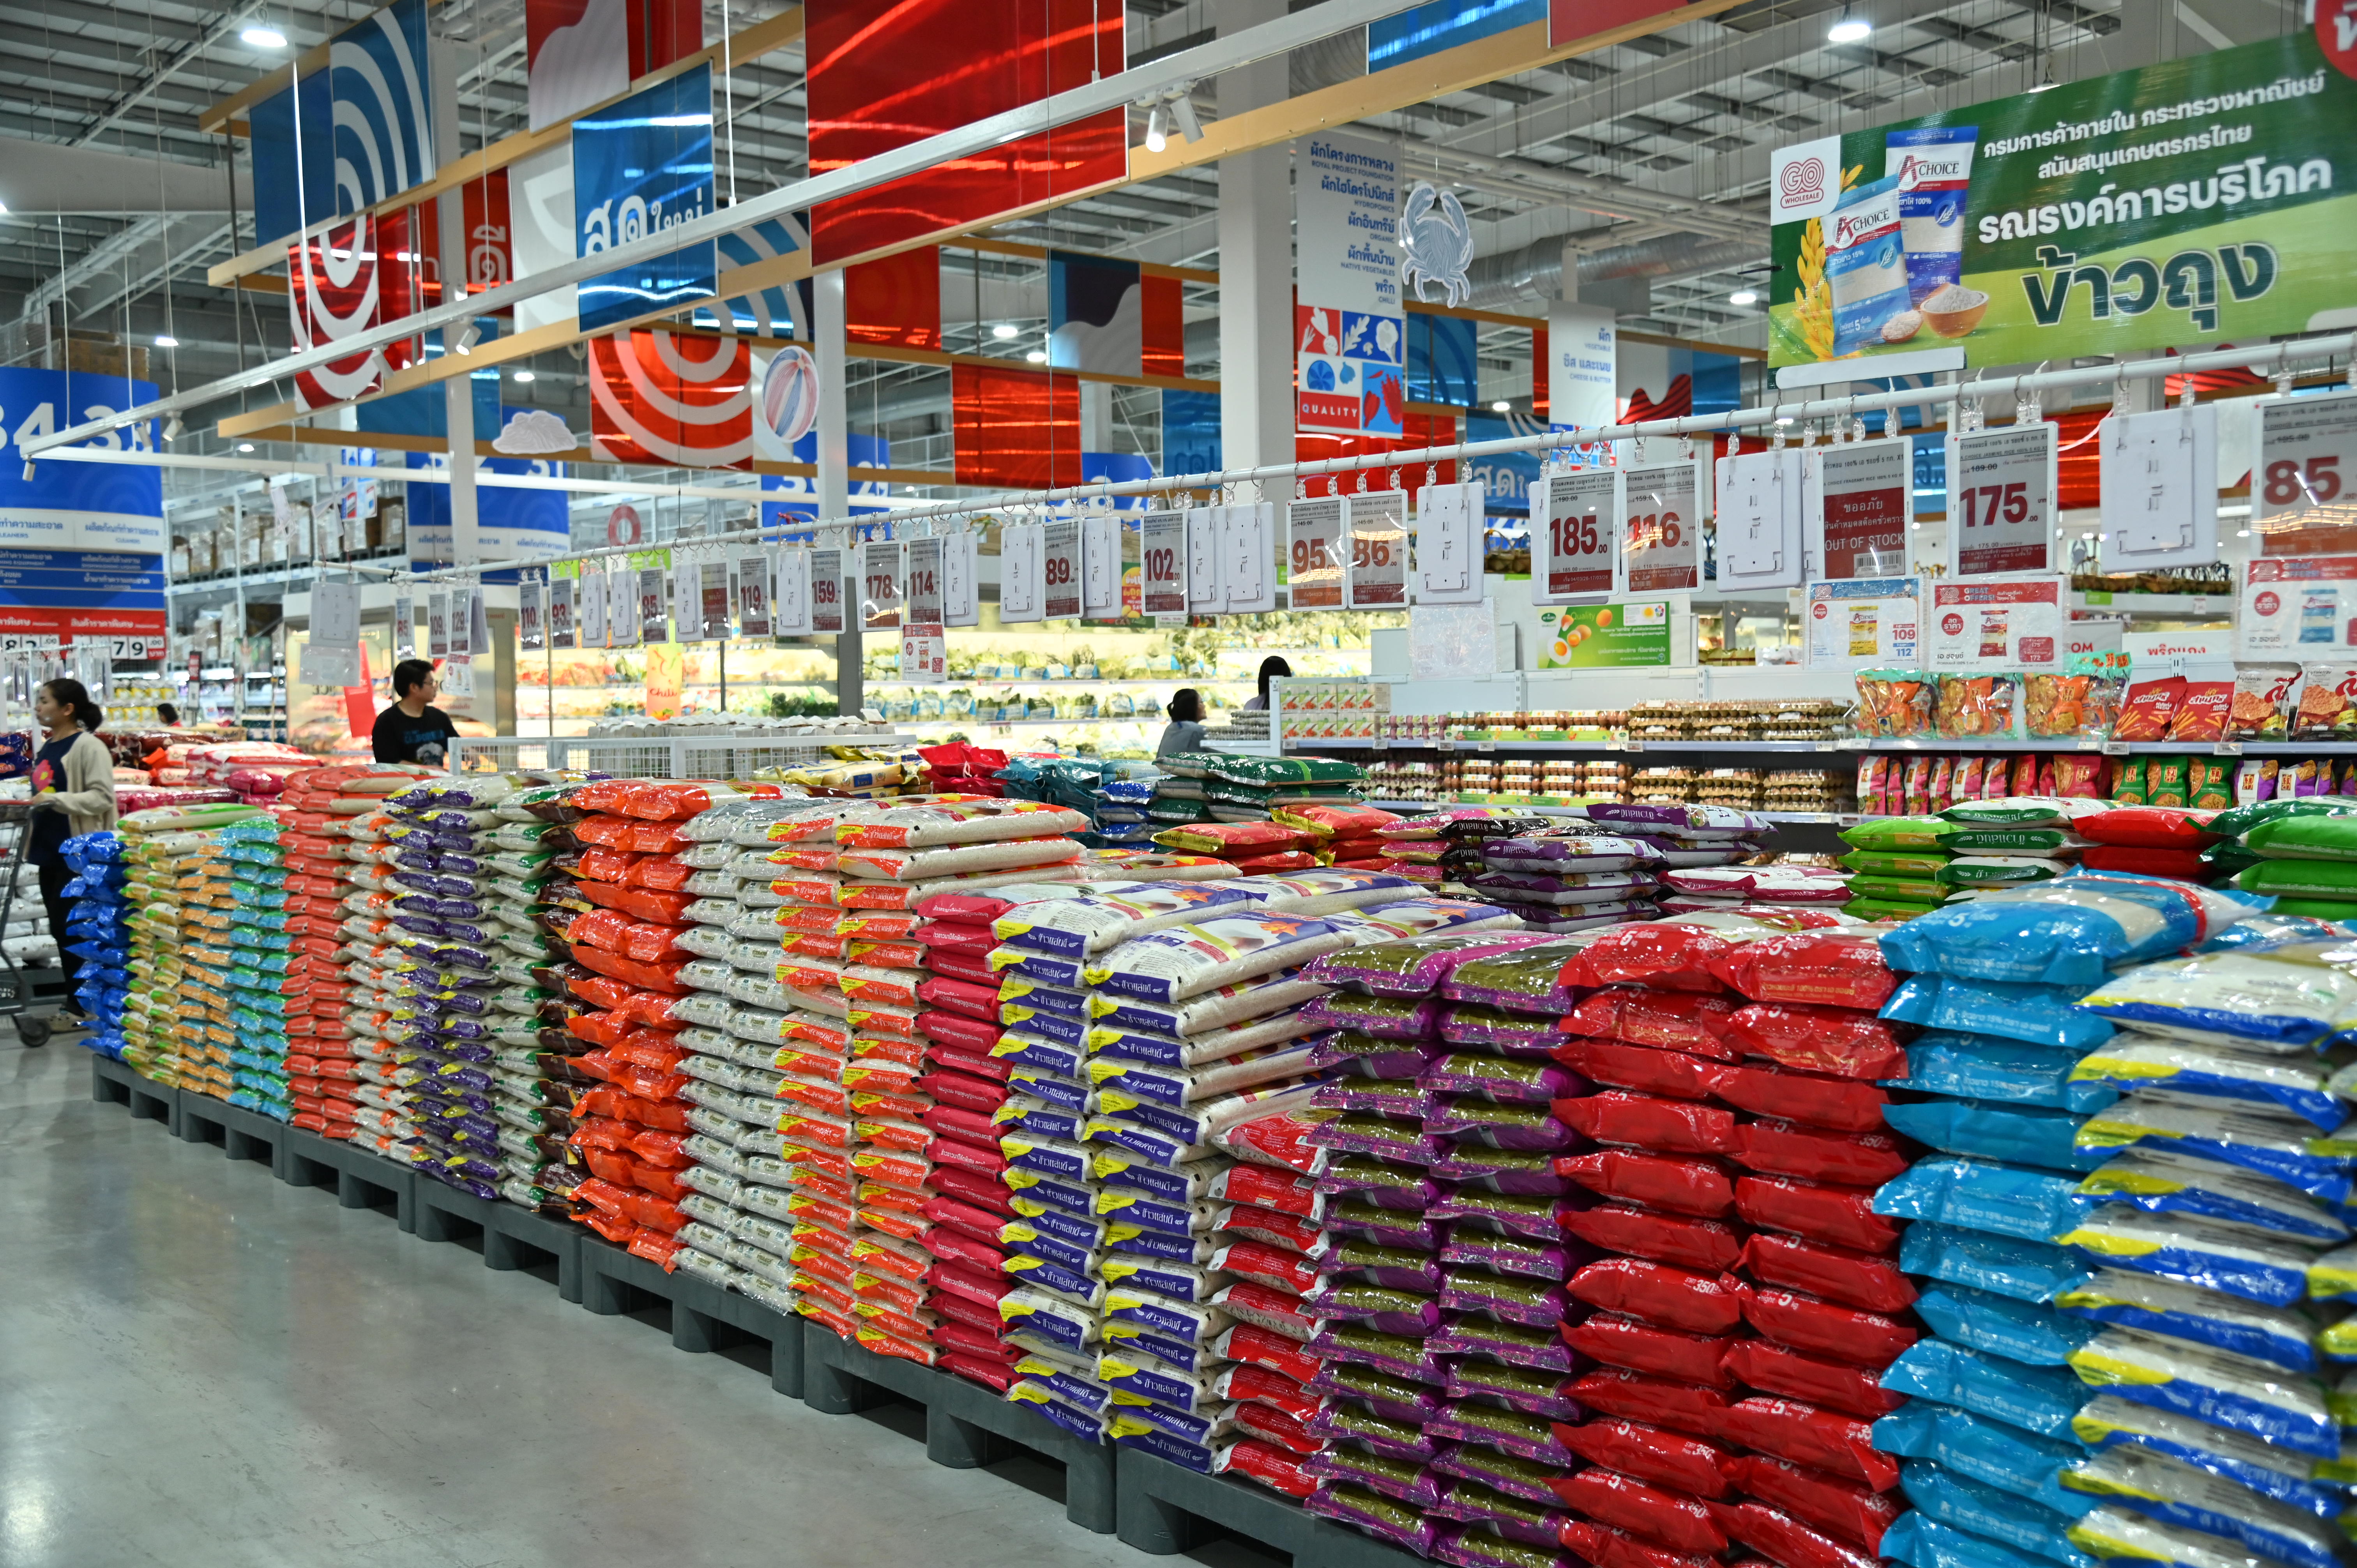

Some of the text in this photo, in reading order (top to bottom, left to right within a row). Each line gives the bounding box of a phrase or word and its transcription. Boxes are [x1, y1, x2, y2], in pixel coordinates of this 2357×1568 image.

[1984, 69, 2326, 157] กรมการค้าภายใน กระทรวงพาณิชย์
[1311, 141, 1394, 172] ผักโครงการหลวง
[2039, 124, 2252, 178] สนับสนุนเกษตรกรไทย
[1312, 161, 1394, 182] ROYAL PROJECT FOUNDATION
[1781, 157, 1824, 195] GO
[1919, 162, 1959, 176] CHOICE
[1322, 175, 1394, 203] ผักไฮโดรโปนิกส์
[1355, 200, 1394, 212] HYDROPONICS
[1785, 192, 1820, 204] WHOLESALE
[1979, 157, 2332, 244] รณรงค์การบริโภค
[1348, 211, 1394, 233] ผักอินทรีย์
[1853, 209, 1890, 231] CHOICE
[1370, 234, 1394, 243] ORGANIC
[1348, 243, 1395, 266] ผักพื้นบ้าน
[1341, 262, 1395, 276] NATIVE VEGETABLES
[1375, 279, 1395, 294] พริก
[2021, 242, 2277, 331] ข้าวถุง
[1599, 328, 1610, 342] ผัก
[1585, 343, 1611, 351] VEGETABLE
[1570, 373, 1588, 381] CHEESE
[1303, 404, 1357, 418] QUALITY
[1960, 440, 1988, 450] ข้าวหอมมะลิ
[1866, 455, 1880, 464] ชอยซ์
[2264, 456, 2341, 505] 85
[1844, 496, 1883, 513] ขออภัย
[1960, 482, 2028, 527] 175
[1550, 515, 1607, 556] 185 .00
[1628, 512, 1680, 550] 116
[1825, 532, 1905, 551] OUT OF STOCK
[1292, 539, 1326, 574] 95
[1353, 538, 1389, 568] 86
[1046, 557, 1070, 585] 89
[1144, 548, 1174, 581] 102
[866, 574, 892, 599] 178
[910, 570, 934, 596] 114
[741, 585, 761, 611] 119
[812, 580, 835, 604] 159
[552, 604, 567, 624] 93
[642, 595, 658, 620] 85
[521, 607, 536, 629] 110
[1571, 612, 1595, 622] Quality
[1892, 629, 1916, 640] 109
[113, 641, 144, 656] 79
[1896, 648, 1912, 657] 112
[1977, 834, 2025, 845] ข้าวแสนดี
[1039, 934, 1067, 948] ข้าวแสนดี
[1620, 931, 1637, 946] 5
[1768, 940, 1786, 955] 5
[1851, 948, 1876, 960] 350
[1122, 980, 1151, 993] ข้าวแสนดี
[1705, 999, 1727, 1012] 350
[1041, 1021, 1069, 1037] ข้าวแสนดี
[1035, 1052, 1063, 1067] ข้าวแสนดี
[1130, 1044, 1162, 1058] ข้าวแสนดี
[1033, 1118, 1060, 1131] ข้าวแสนดี
[1147, 1113, 1180, 1133] ข้าวแสนดี
[1859, 1134, 1883, 1148] 350
[1138, 1174, 1170, 1192] ข้าวแสนดี
[1142, 1208, 1173, 1225] ข้าวแสนดี
[1051, 1219, 1081, 1236] ข้าวแสนดี
[1048, 1271, 1078, 1290] ข้าวแสนดี
[1693, 1279, 1716, 1293] 350
[1778, 1291, 1794, 1306] 5
[1043, 1319, 1070, 1337] ข้าวแสนดี
[1597, 1321, 1616, 1329] Weight
[1145, 1379, 1178, 1397] ข้าวแสนดี
[1746, 1403, 1769, 1413] Weight
[1771, 1399, 1790, 1414] 5
[1057, 1409, 1086, 1430] ข้าวแสนดี
[1617, 1420, 1630, 1435] 5
[1157, 1439, 1191, 1459] ข้าวแสนดี
[1586, 1474, 1606, 1483] Weight
[1608, 1474, 1621, 1489] 5
